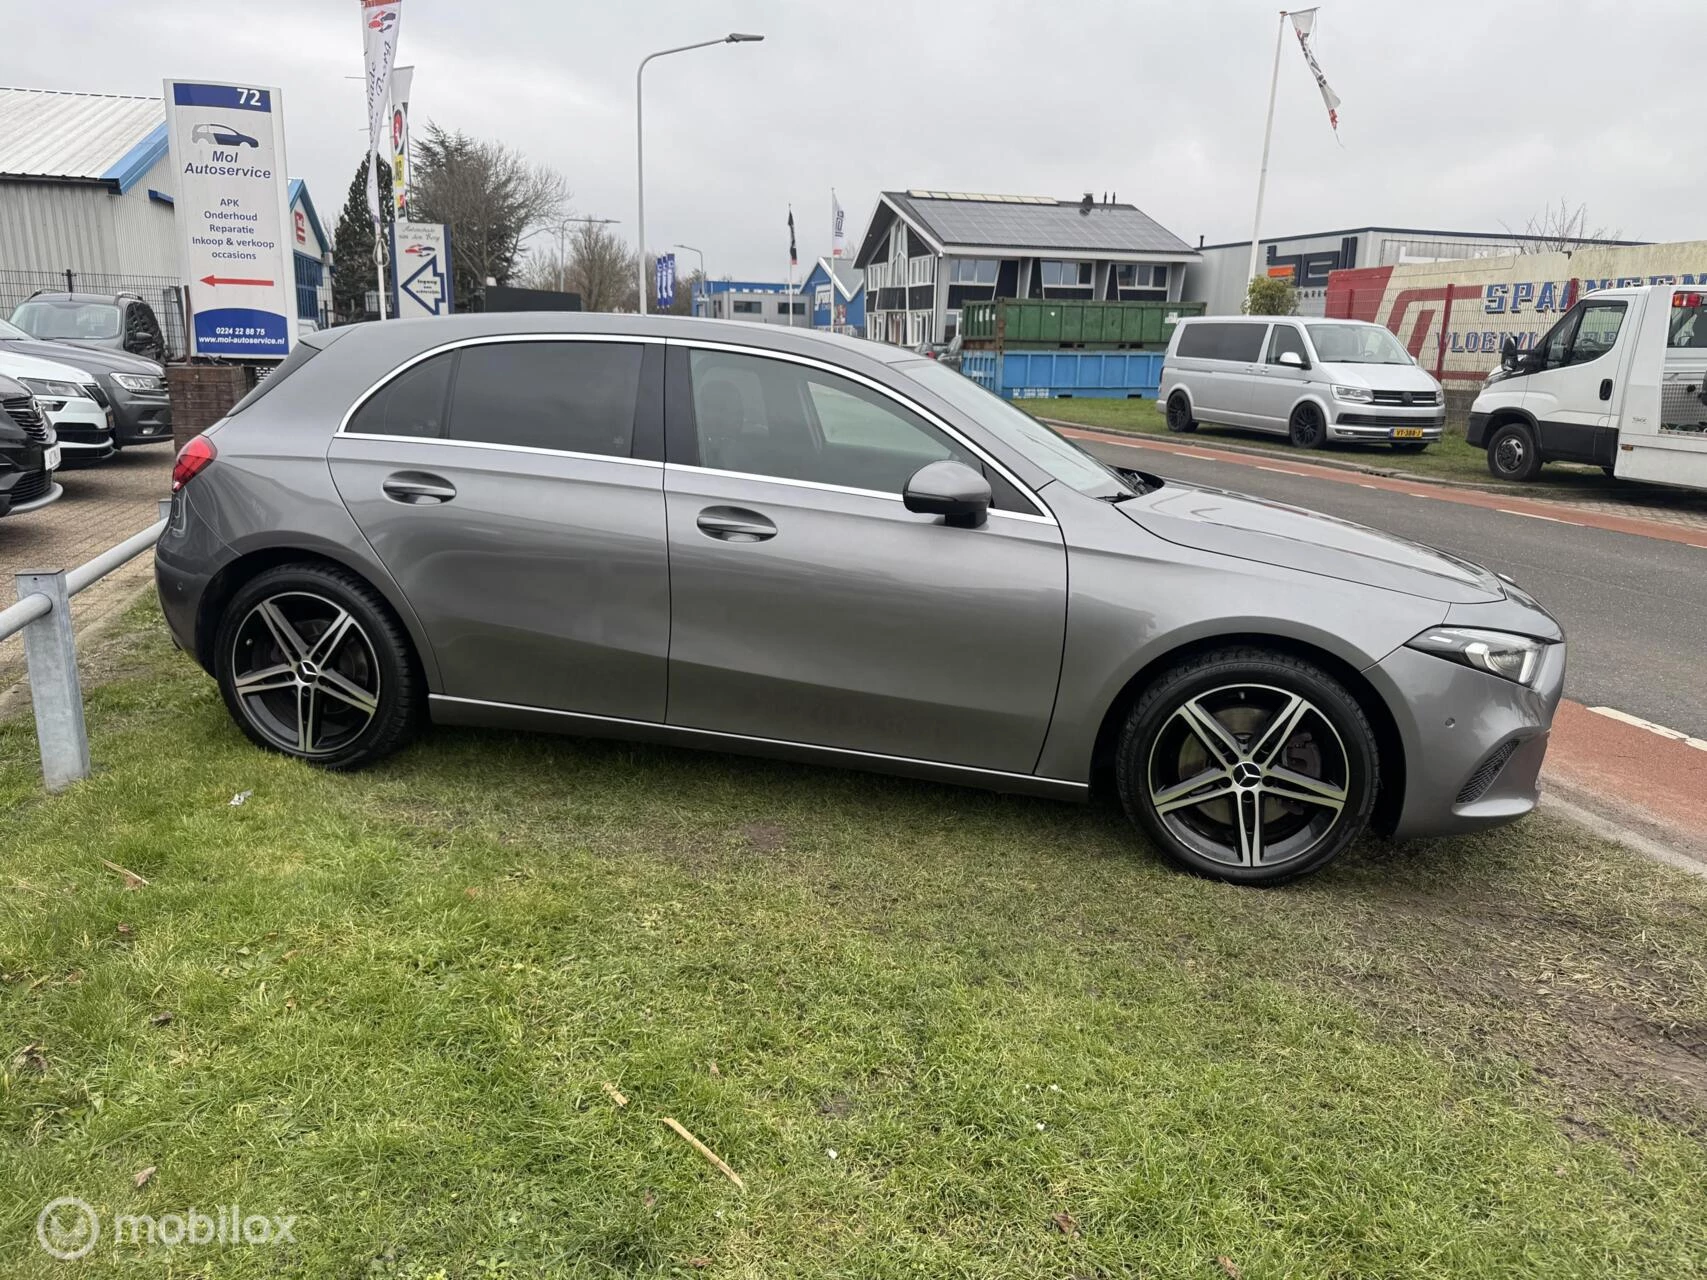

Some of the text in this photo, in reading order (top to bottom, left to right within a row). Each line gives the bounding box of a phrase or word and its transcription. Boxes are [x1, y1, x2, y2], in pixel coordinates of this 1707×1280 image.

[237, 88, 261, 106] 72
[212, 151, 239, 163] Mol
[184, 162, 271, 179] Autoservice
[220, 198, 240, 207] APK
[204, 210, 258, 221] Onderhoud
[209, 224, 255, 234] Reparatie
[192, 236, 275, 249] Inkoop & verkoop
[211, 251, 257, 260] occasions
[216, 327, 233, 335] 0224
[235, 327, 244, 335] 22
[256, 328, 266, 336] 75
[198, 336, 285, 345] www.mol-autoservice.nl
